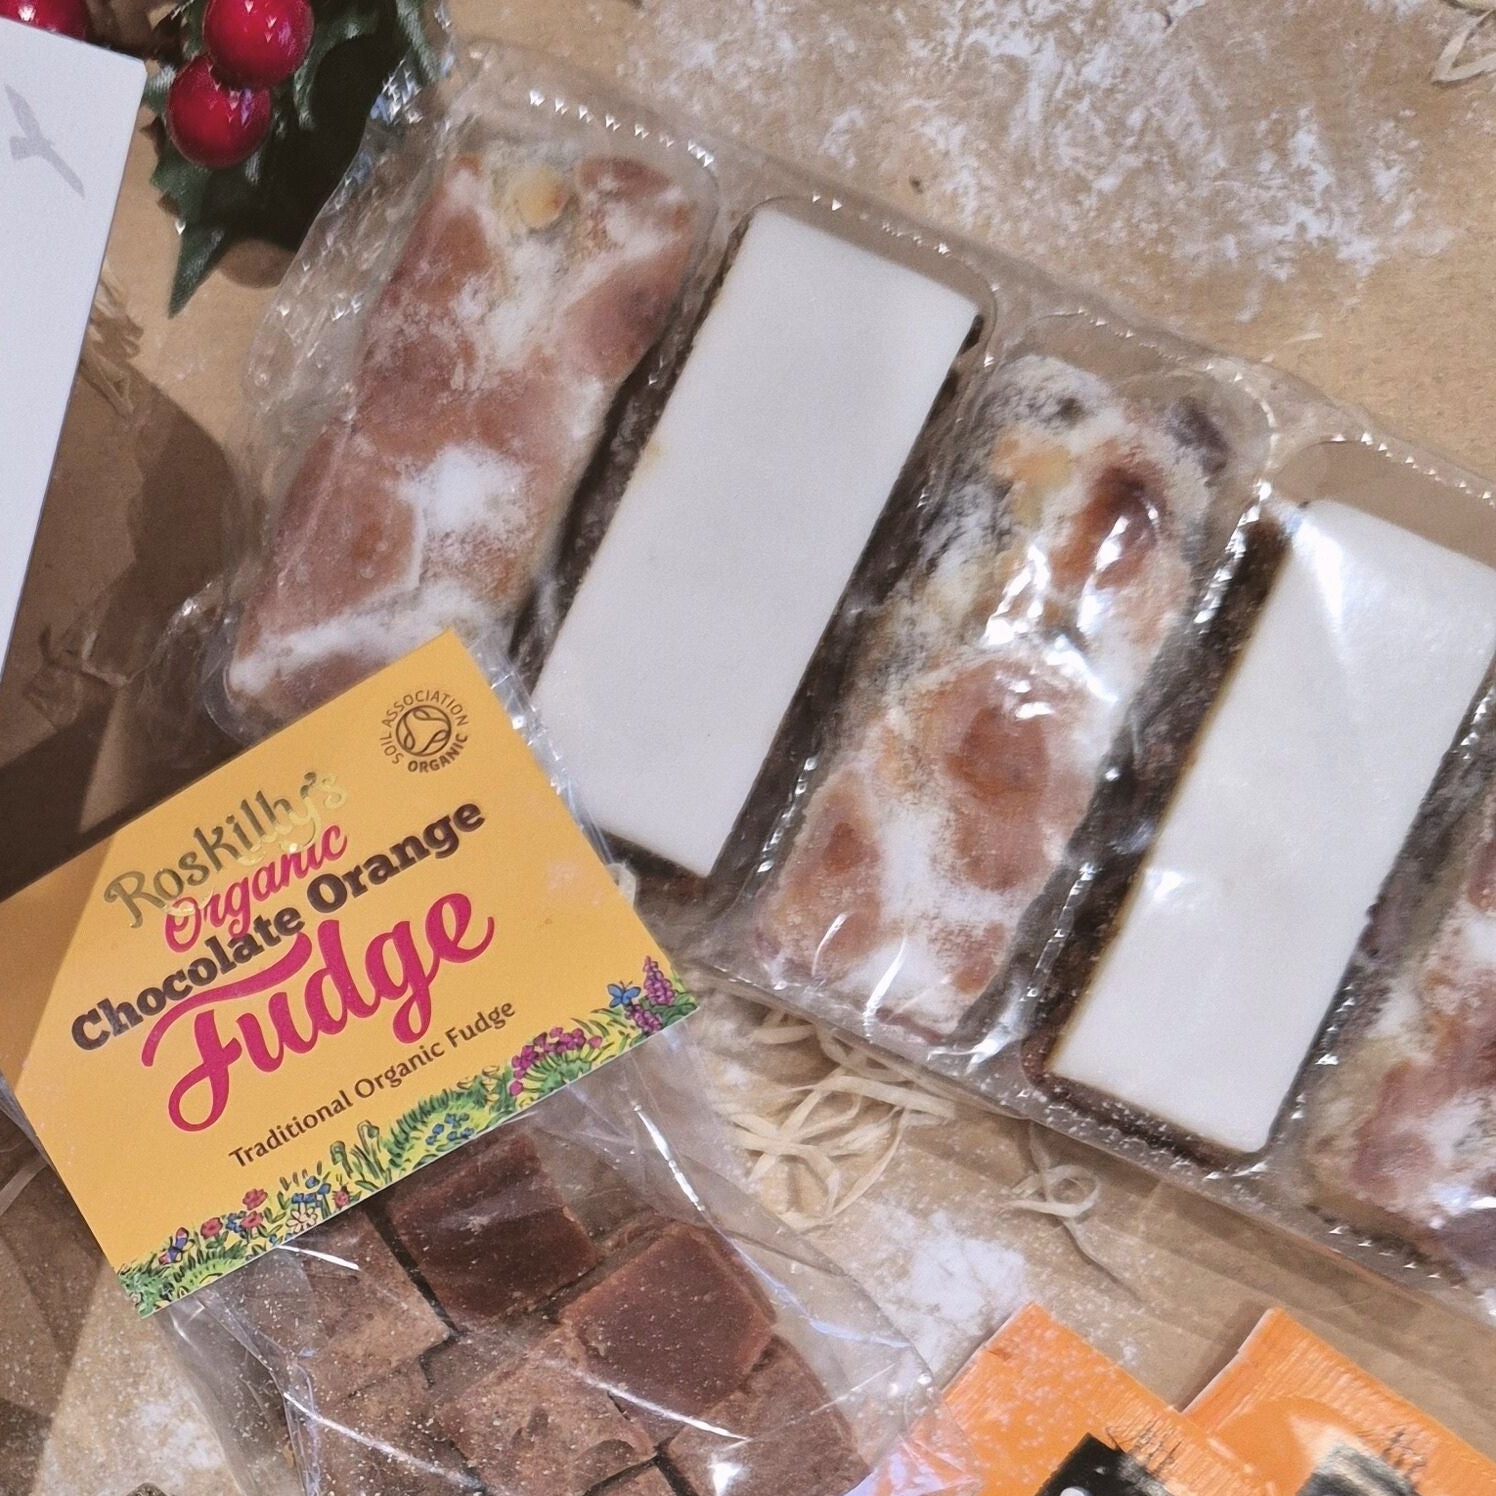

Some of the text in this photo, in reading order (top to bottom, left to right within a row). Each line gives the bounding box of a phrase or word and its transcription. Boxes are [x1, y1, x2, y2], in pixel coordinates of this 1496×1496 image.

[380, 689, 469, 765] SOIL ASSOCIATION
[407, 733, 469, 773] ORGANIC
[71, 802, 486, 1051] Chocolate Orange
[104, 770, 348, 928] Roskilly's
[164, 824, 348, 953] Organic
[140, 891, 495, 1132] Fudge
[228, 999, 516, 1168] Traditional Organic Fudge
